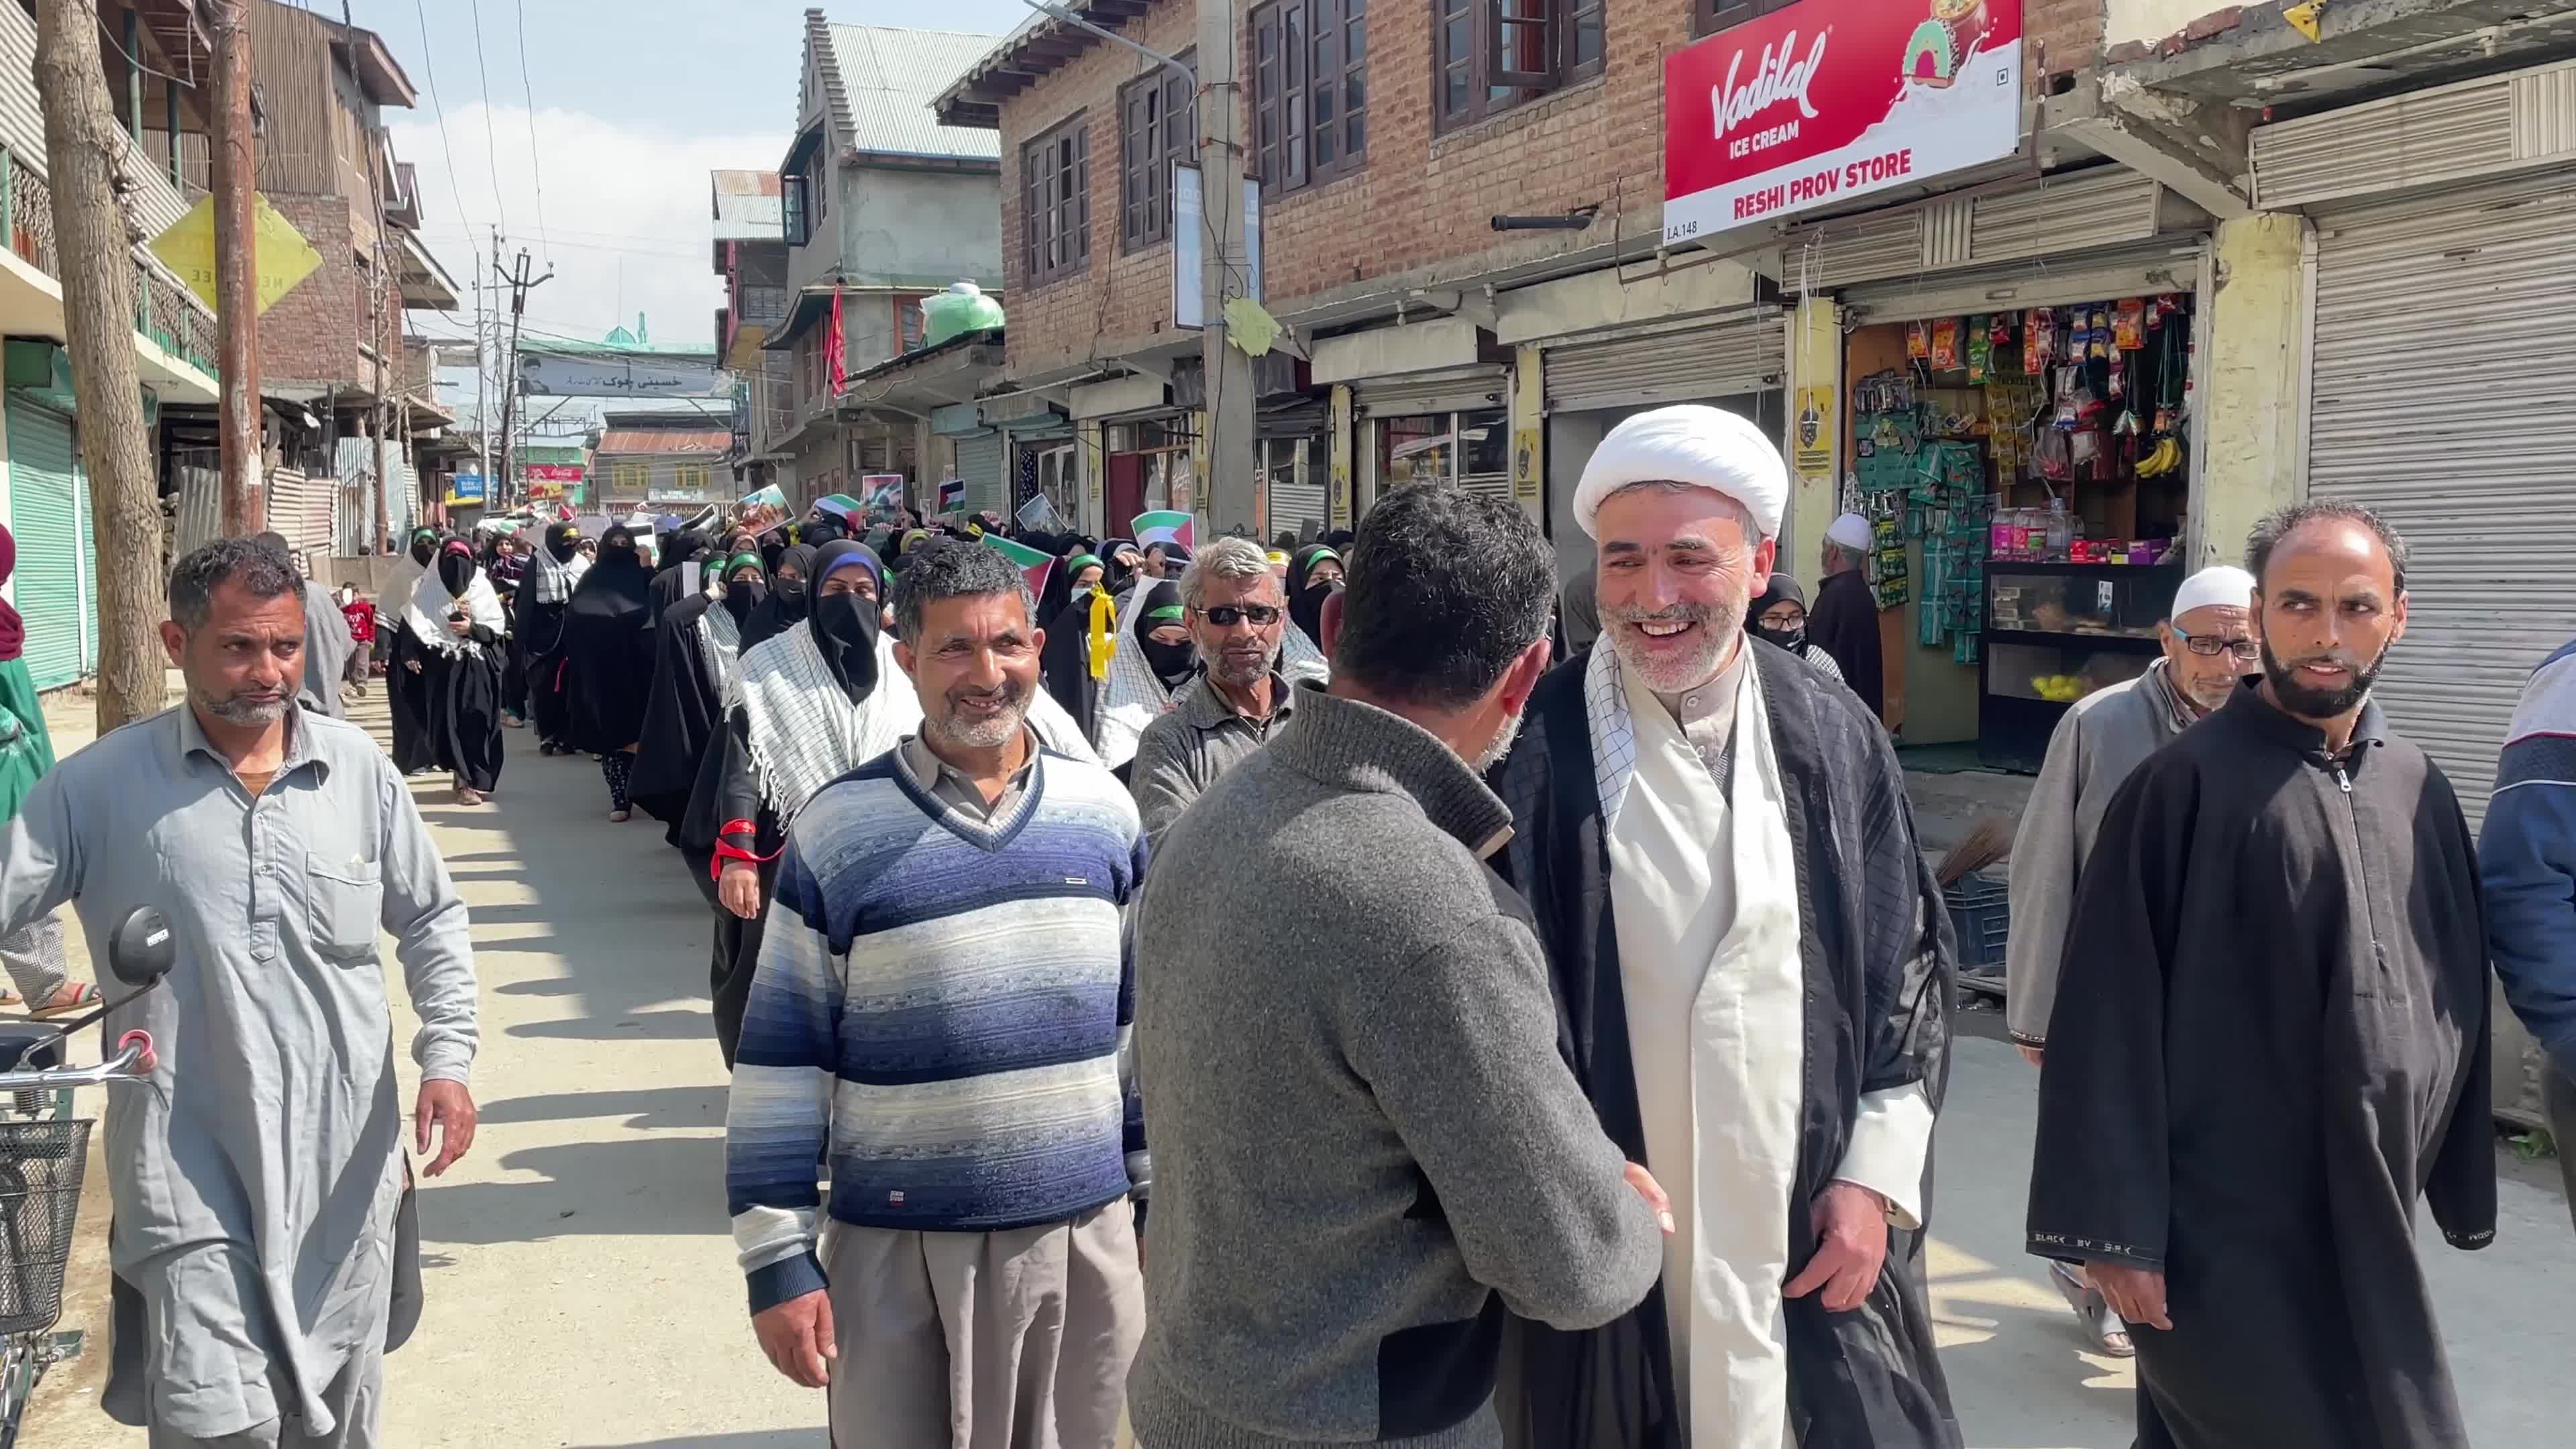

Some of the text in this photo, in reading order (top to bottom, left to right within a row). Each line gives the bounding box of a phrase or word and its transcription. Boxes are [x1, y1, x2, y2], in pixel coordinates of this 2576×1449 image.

[1711, 30, 1826, 140] Vadilal
[1729, 119, 1799, 160] ICE CREAM
[1733, 148, 1911, 220] RESHI PROV STORE
[2035, 1234, 2065, 1244] BLACK
[2077, 1238, 2092, 1248] BY
